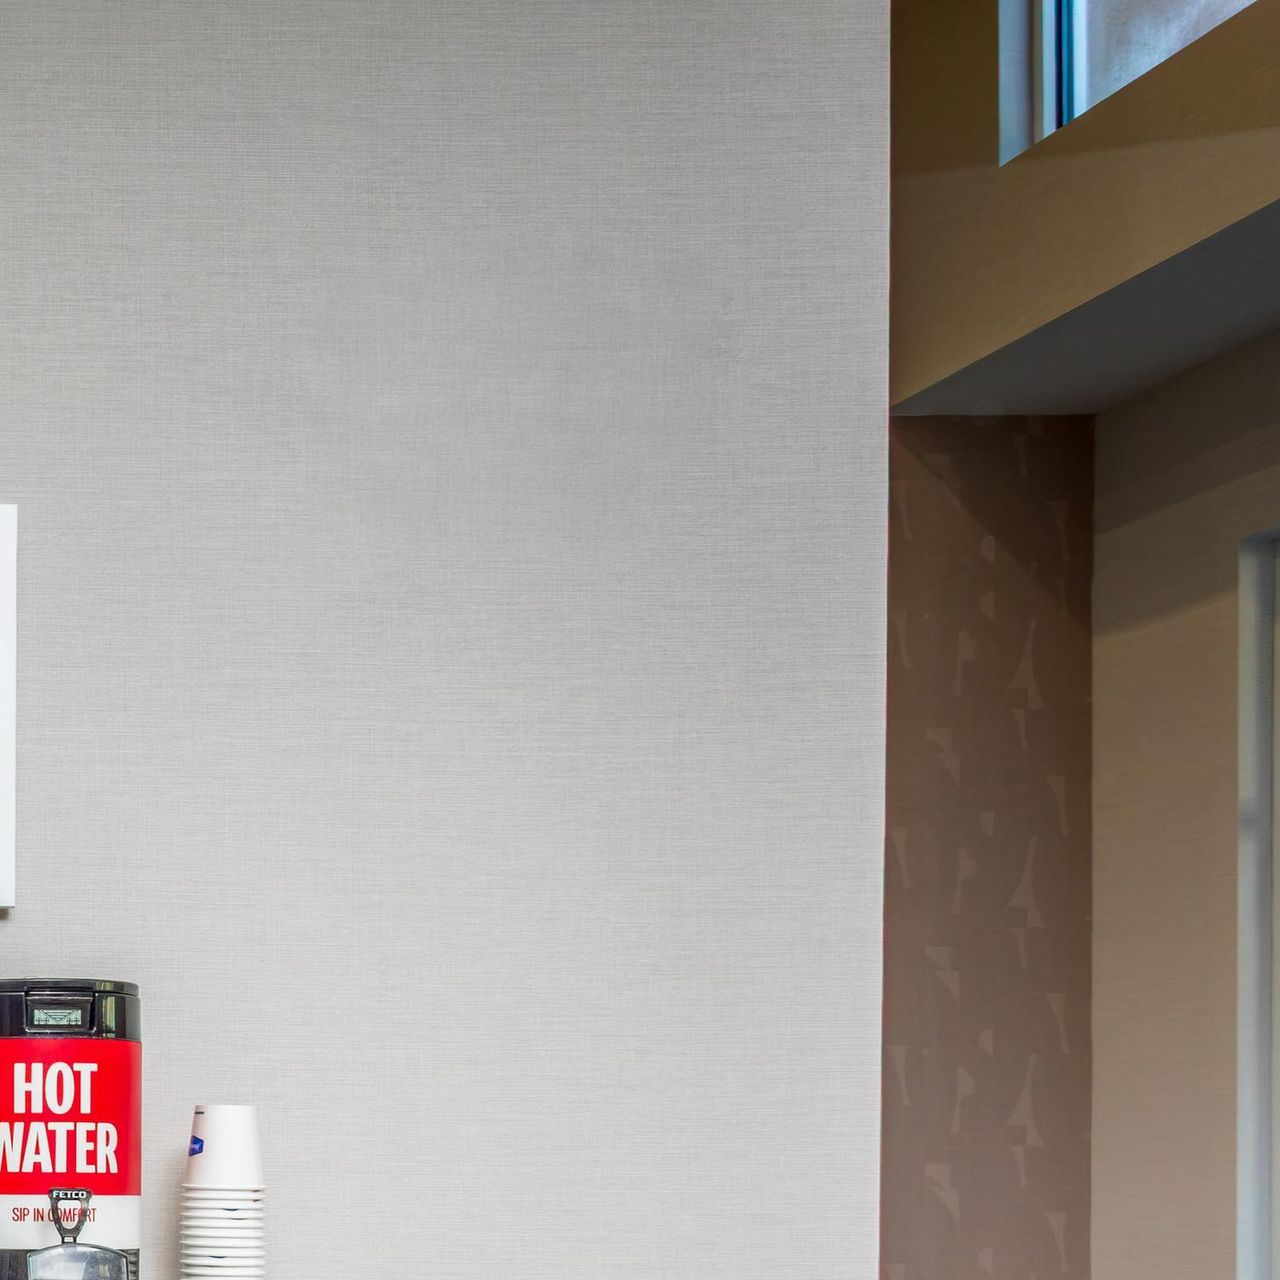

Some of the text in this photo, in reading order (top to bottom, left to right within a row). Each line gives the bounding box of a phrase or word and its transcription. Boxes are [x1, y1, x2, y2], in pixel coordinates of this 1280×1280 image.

[13, 1061, 98, 1115] HOT
[52, 1190, 87, 1199] FETCO
[11, 1207, 30, 1222] SIP
[33, 1207, 45, 1222] IN
